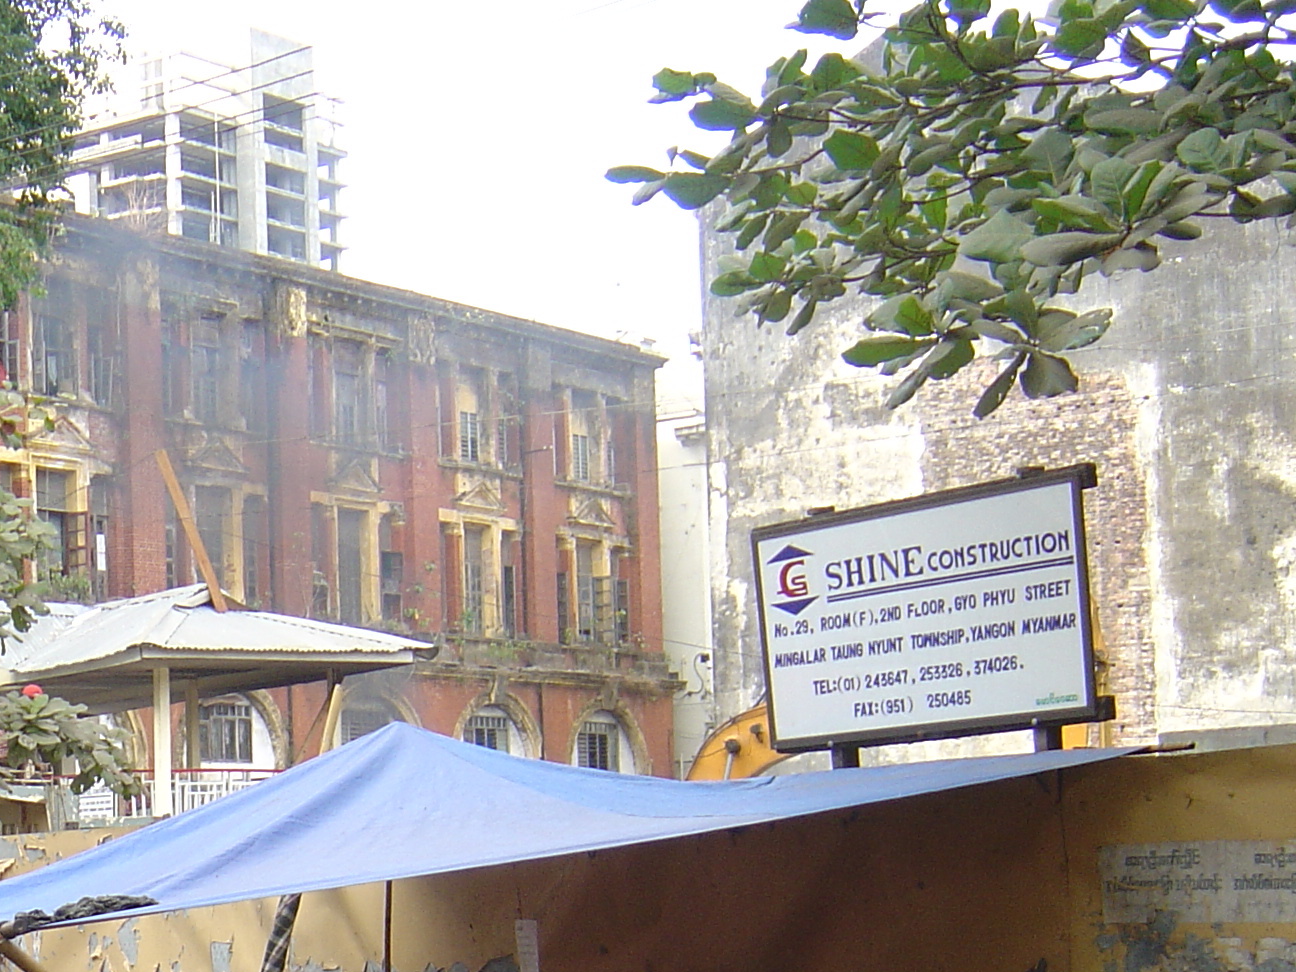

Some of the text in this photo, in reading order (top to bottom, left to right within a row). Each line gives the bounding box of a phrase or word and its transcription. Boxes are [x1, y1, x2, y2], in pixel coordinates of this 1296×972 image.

[825, 530, 1070, 591] SHINE CONSTRUCTION
[983, 588, 1015, 607] PHYU
[1025, 579, 1071, 601] STREET
[774, 648, 827, 668] MINGALAR
[831, 643, 863, 661] TAUNG
[868, 637, 903, 655] NYUNT
[1021, 612, 1076, 634] MYANMAR
[927, 690, 971, 709] 250485
